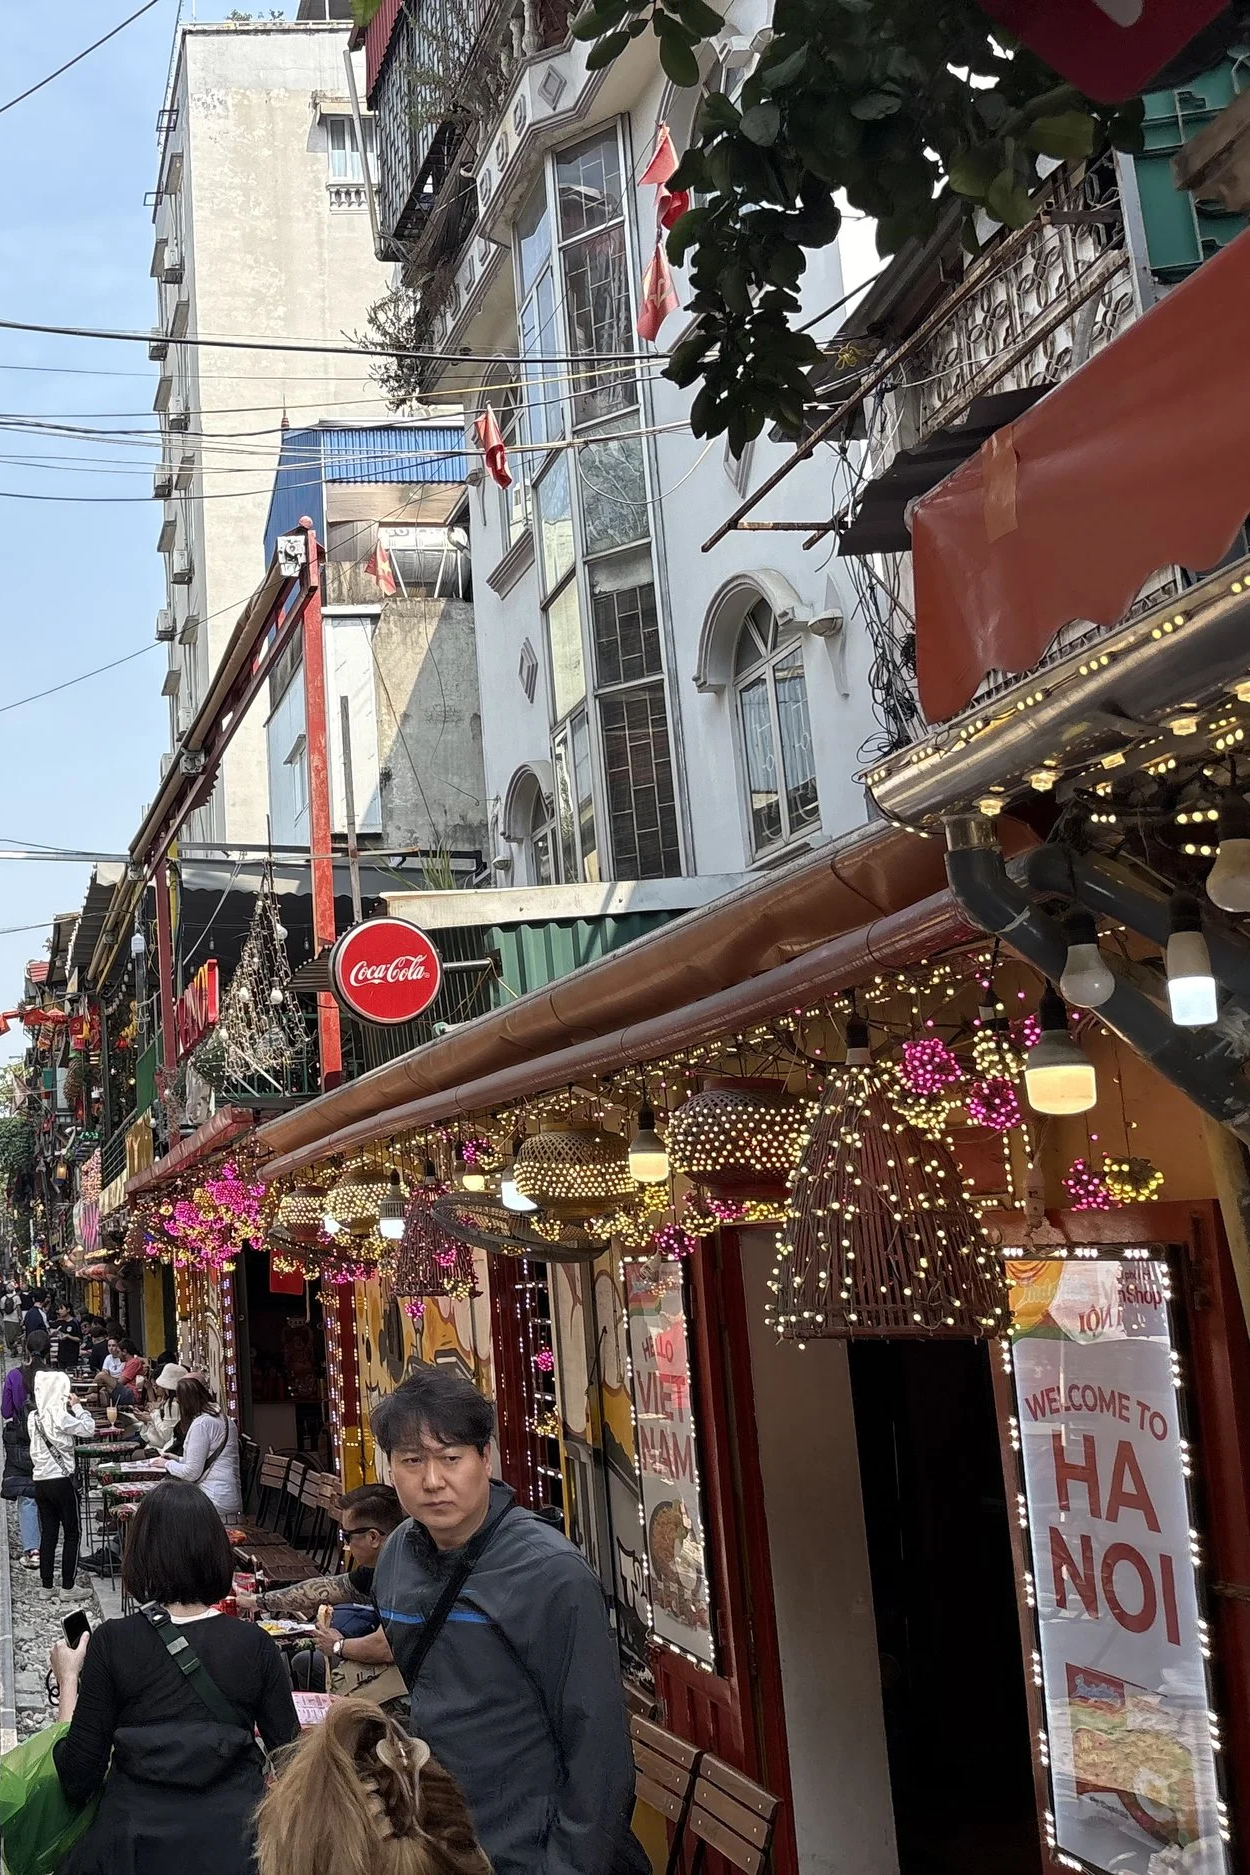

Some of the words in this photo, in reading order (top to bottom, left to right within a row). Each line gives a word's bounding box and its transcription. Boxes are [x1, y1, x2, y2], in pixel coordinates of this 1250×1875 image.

[350, 954, 428, 986] Coca-Cola
[641, 1334, 673, 1363] HELLO
[636, 1369, 686, 1423] VIET
[1024, 1384, 1131, 1423] WELCOME
[1136, 1400, 1168, 1441] TO
[639, 1425, 694, 1484] NAM
[1052, 1429, 1162, 1533] HA
[1049, 1526, 1181, 1646] NOI
